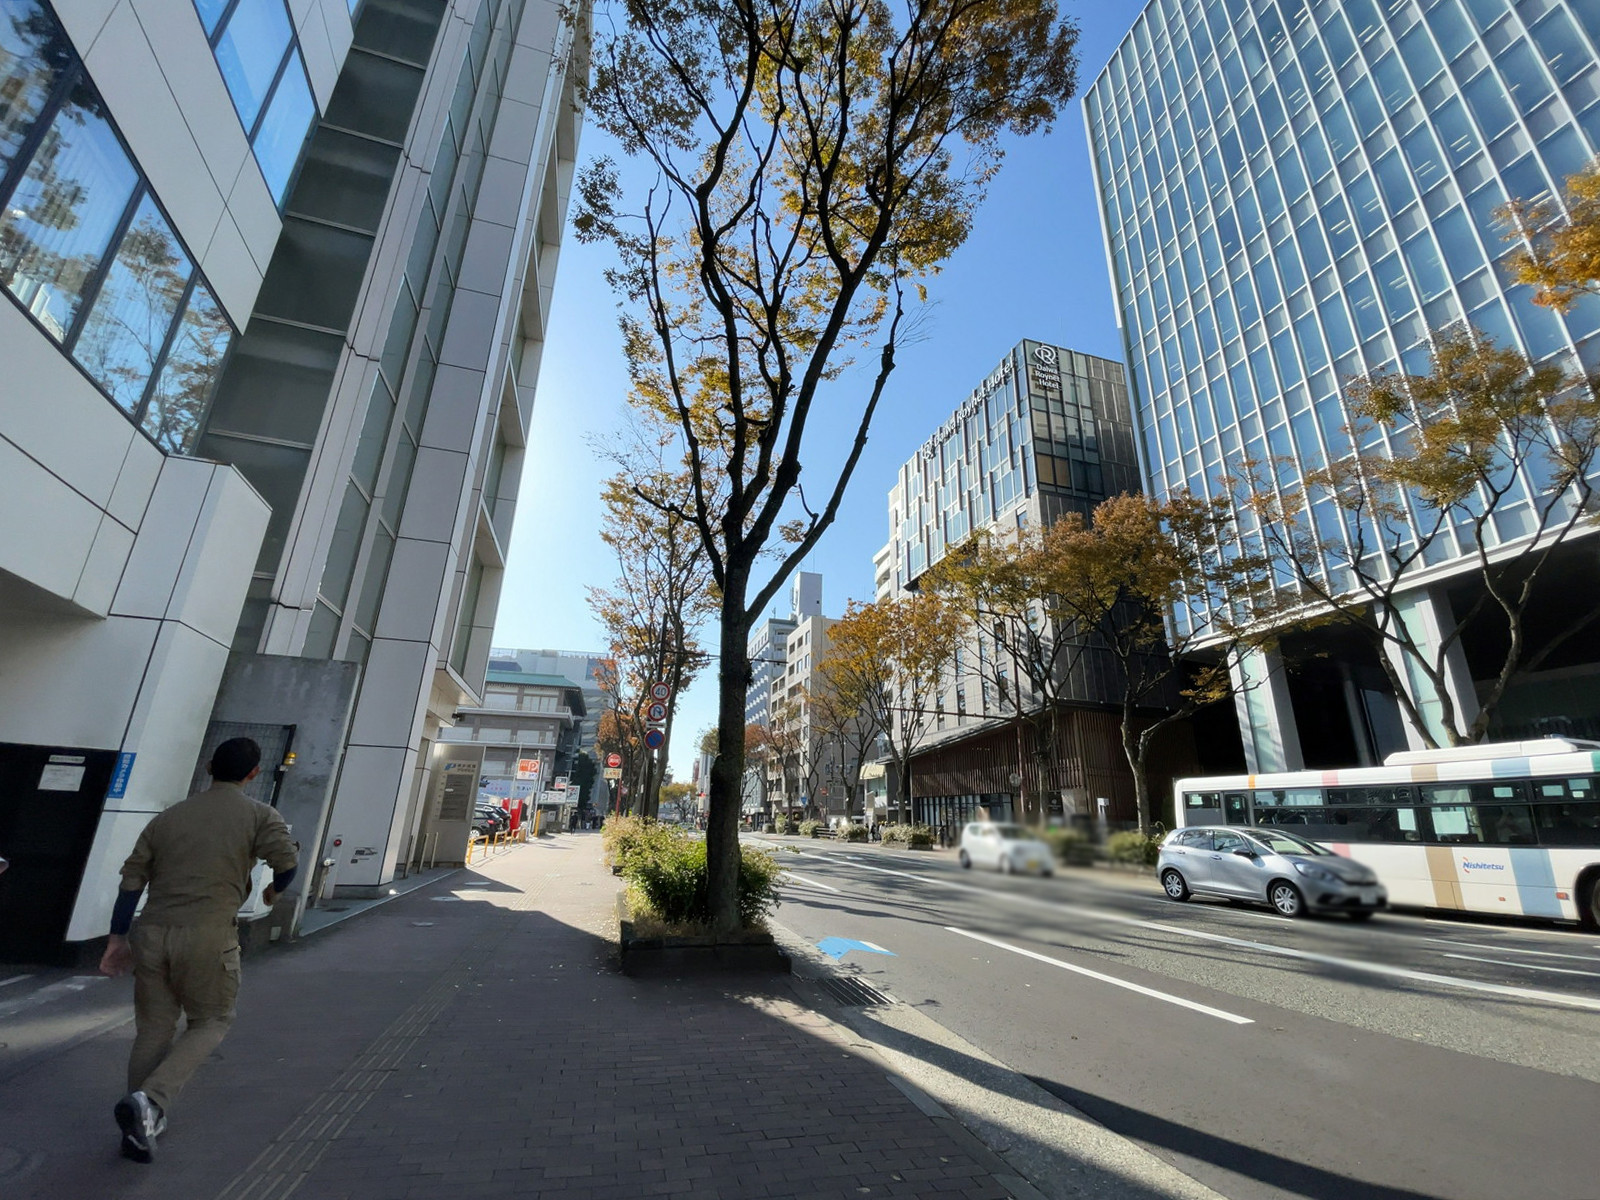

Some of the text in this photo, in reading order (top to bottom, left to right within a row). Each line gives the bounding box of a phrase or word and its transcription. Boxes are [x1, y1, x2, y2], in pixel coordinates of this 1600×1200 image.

[986, 354, 1015, 391] Hotel
[1036, 363, 1058, 375] Daiwa
[1034, 370, 1060, 382] Roynet
[1038, 379, 1060, 390] Hotel
[655, 687, 667, 696] 40
[527, 760, 539, 771] P
[1463, 862, 1504, 871] Nishitetsu
